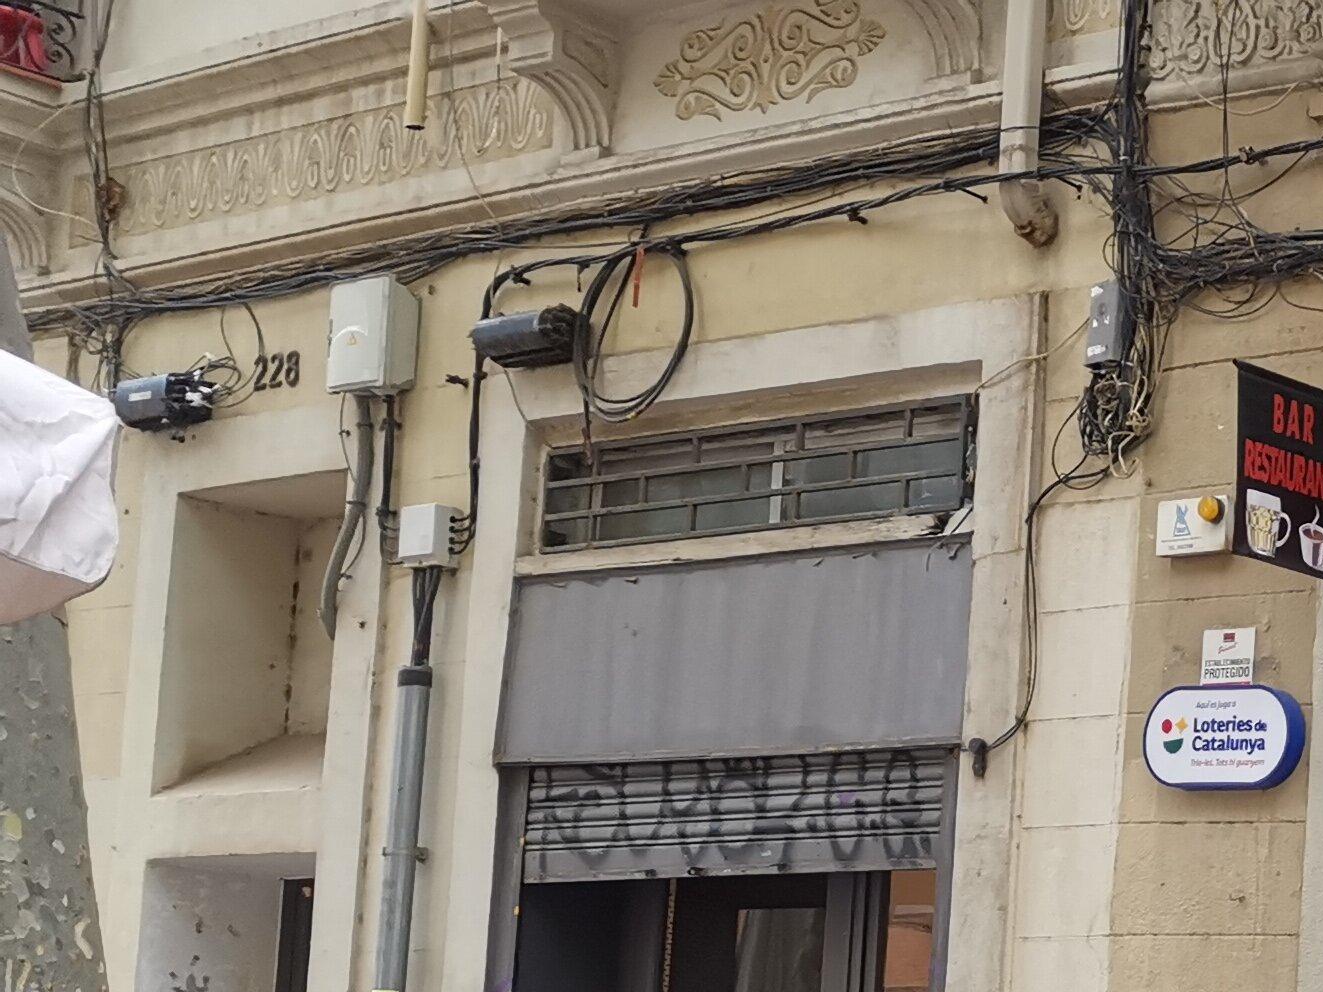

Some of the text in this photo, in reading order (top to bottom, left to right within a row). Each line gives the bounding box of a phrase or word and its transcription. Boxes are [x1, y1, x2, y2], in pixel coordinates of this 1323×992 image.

[253, 350, 300, 392] 228
[1271, 393, 1317, 445] BAR
[1204, 666, 1250, 679] PROTEGIDO
[1193, 715, 1267, 733] Loteries de
[1191, 735, 1265, 755] Catalunya
